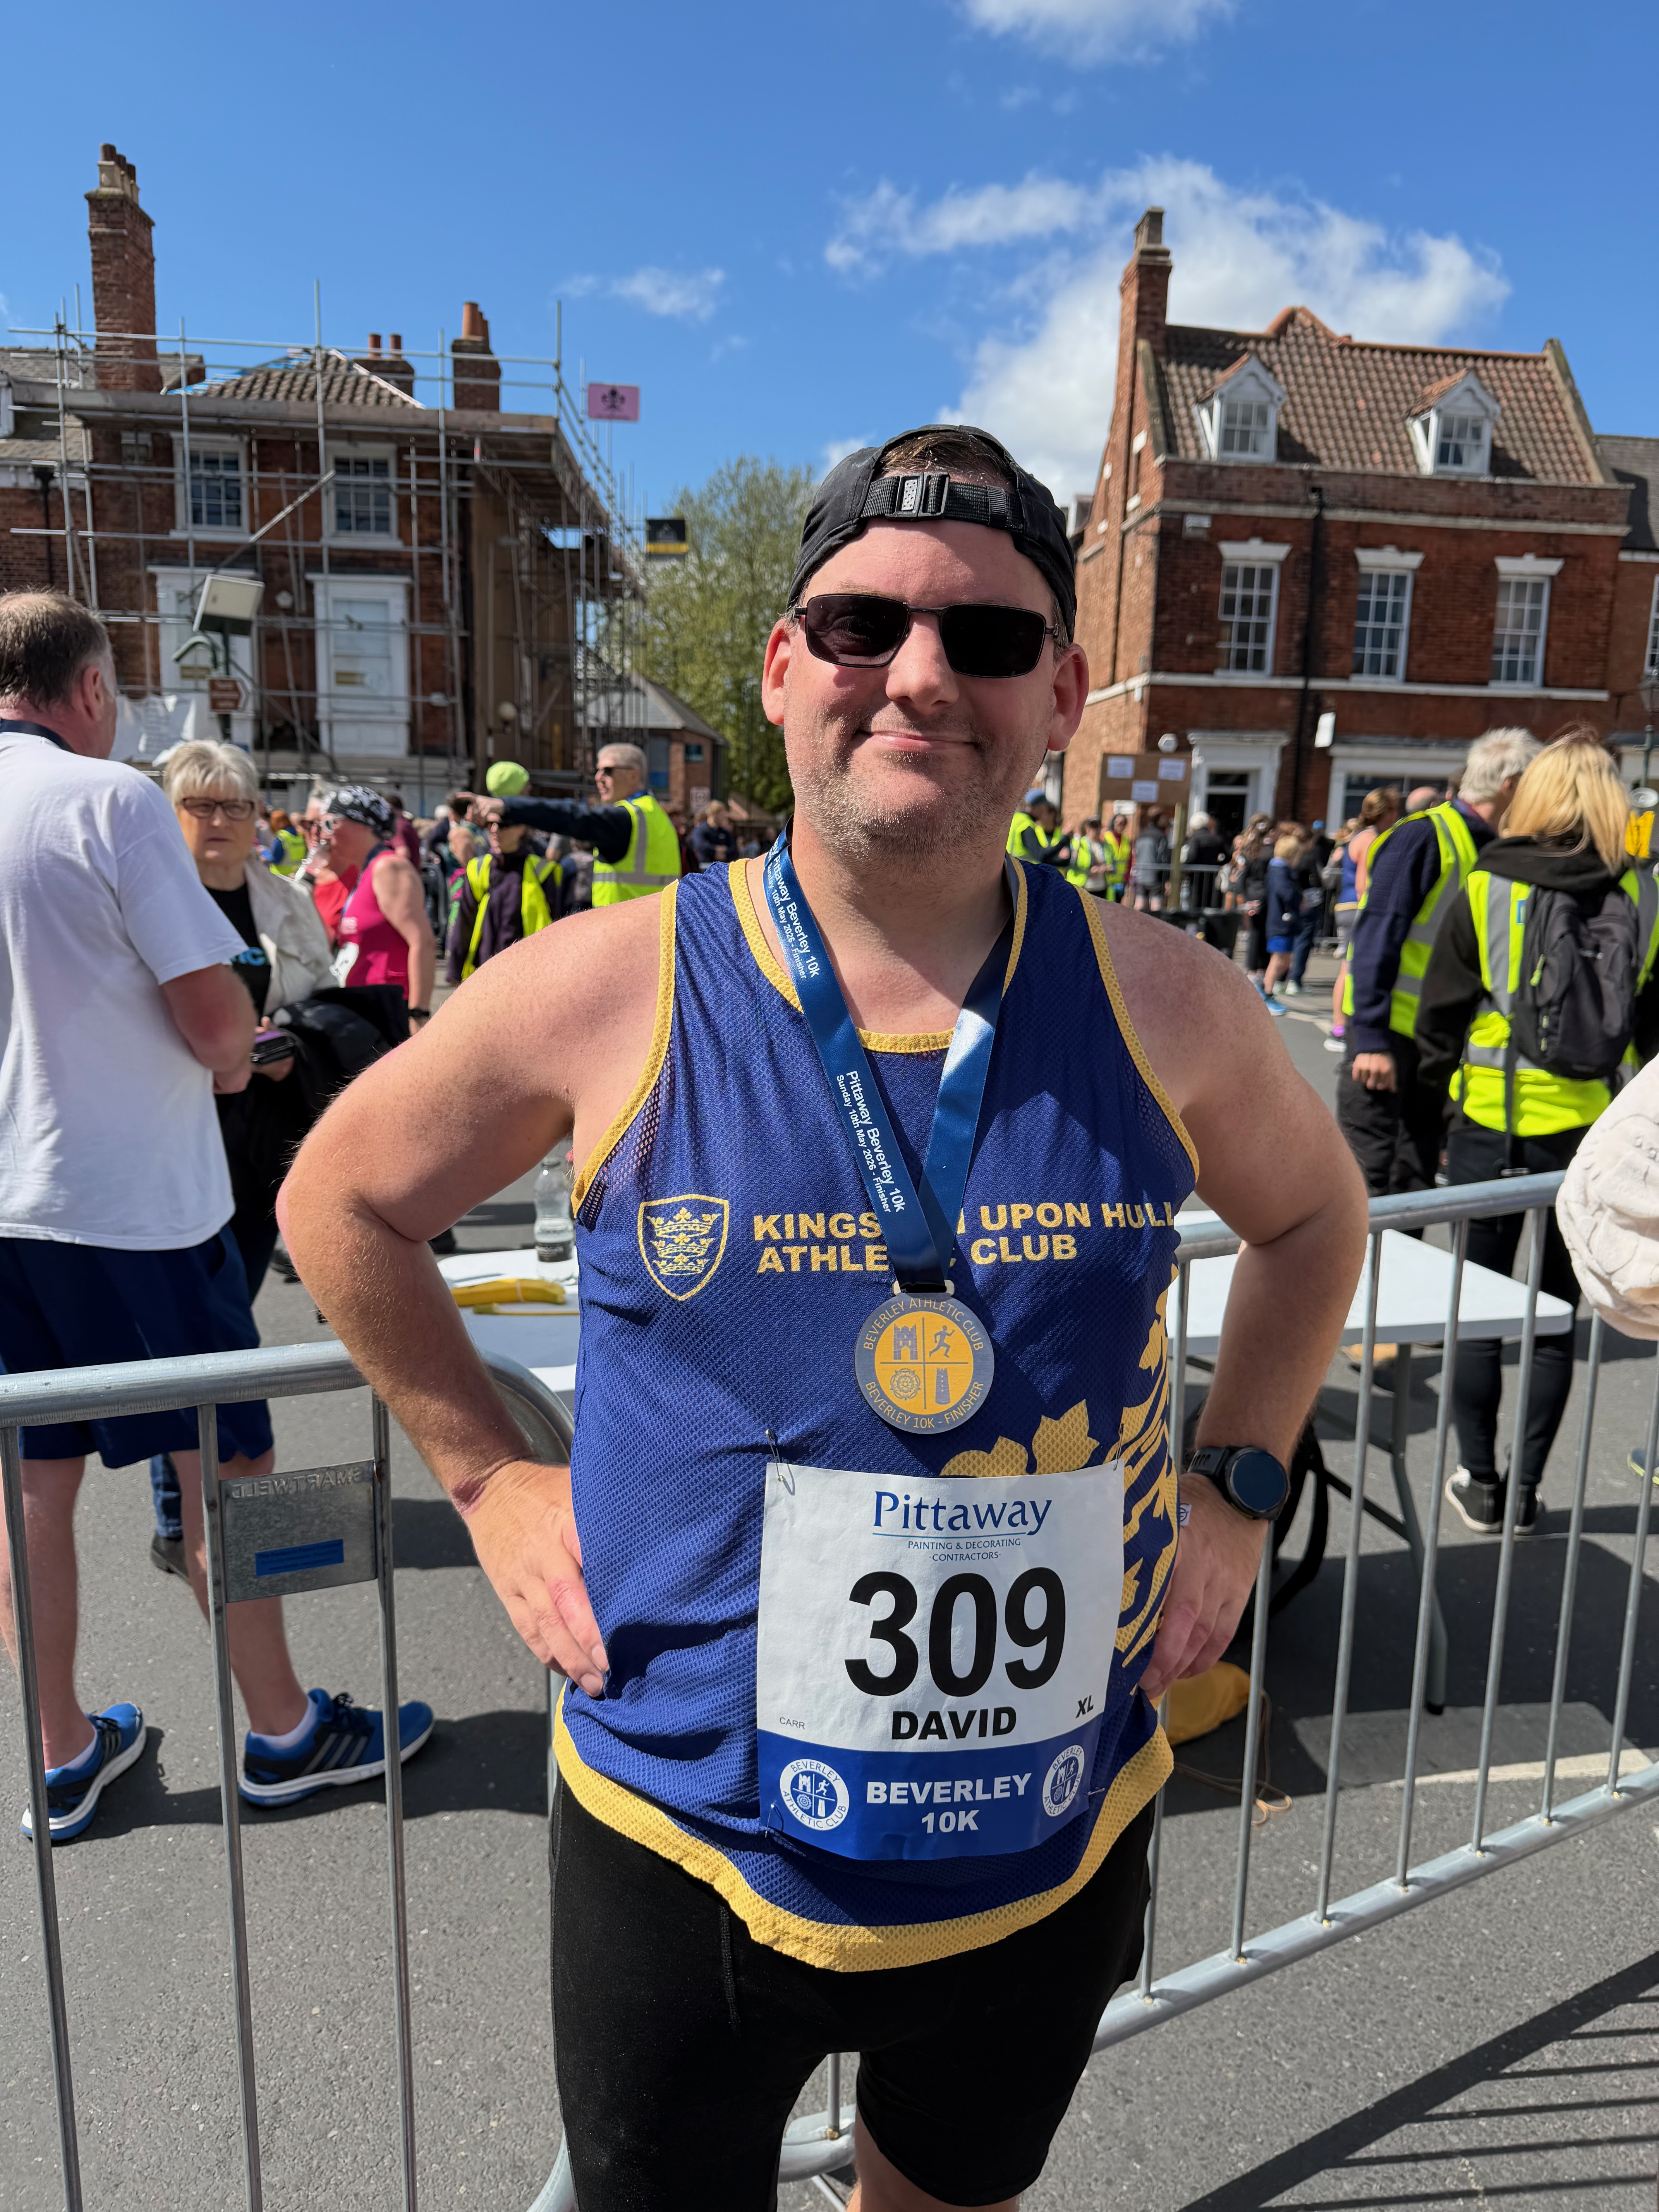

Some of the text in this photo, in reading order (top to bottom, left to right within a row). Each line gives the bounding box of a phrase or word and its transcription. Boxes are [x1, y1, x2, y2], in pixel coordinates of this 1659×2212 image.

[773, 854, 820, 978] Pittaway Beverley 10k
[772, 890, 781, 907] 10th
[777, 907, 787, 924] May
[783, 924, 795, 943] 2026
[792, 947, 807, 979] Finisher
[836, 1075, 852, 1107] Sunday
[849, 1109, 859, 1128] 10th
[856, 1129, 867, 1147] May
[863, 1149, 876, 1171] 2026
[873, 1176, 891, 1213] Finisher
[846, 1070, 906, 1212] Pittaway Beverley 10k
[980, 1202, 1091, 1231] UPON
[1101, 1202, 1174, 1228] HULL
[970, 1234, 1077, 1265] CLUB
[863, 1298, 984, 1350] BEVERLEY ATHLETIC CLUB
[866, 1381, 910, 1425] BEVERLEY
[913, 1417, 935, 1428] 10K
[944, 1381, 984, 1424] FINISHER
[873, 1491, 1052, 1535] Pittaway
[908, 1541, 952, 1550] PAINTING
[966, 1538, 1021, 1549] DECORATING
[844, 1567, 1065, 1698] 309
[779, 1716, 805, 1730] CARR
[891, 1707, 1017, 1740] DAVID
[1075, 1694, 1094, 1719] XL
[790, 1761, 840, 1782] BEVERLEY
[1053, 1747, 1082, 1770] BEVERLEY
[867, 1773, 1031, 1804] BEVERLEY
[1044, 1772, 1081, 1814] ATHLETIC CLUB
[783, 1791, 846, 1828] ATHLETIC CLUB
[921, 1810, 979, 1833] 10K
